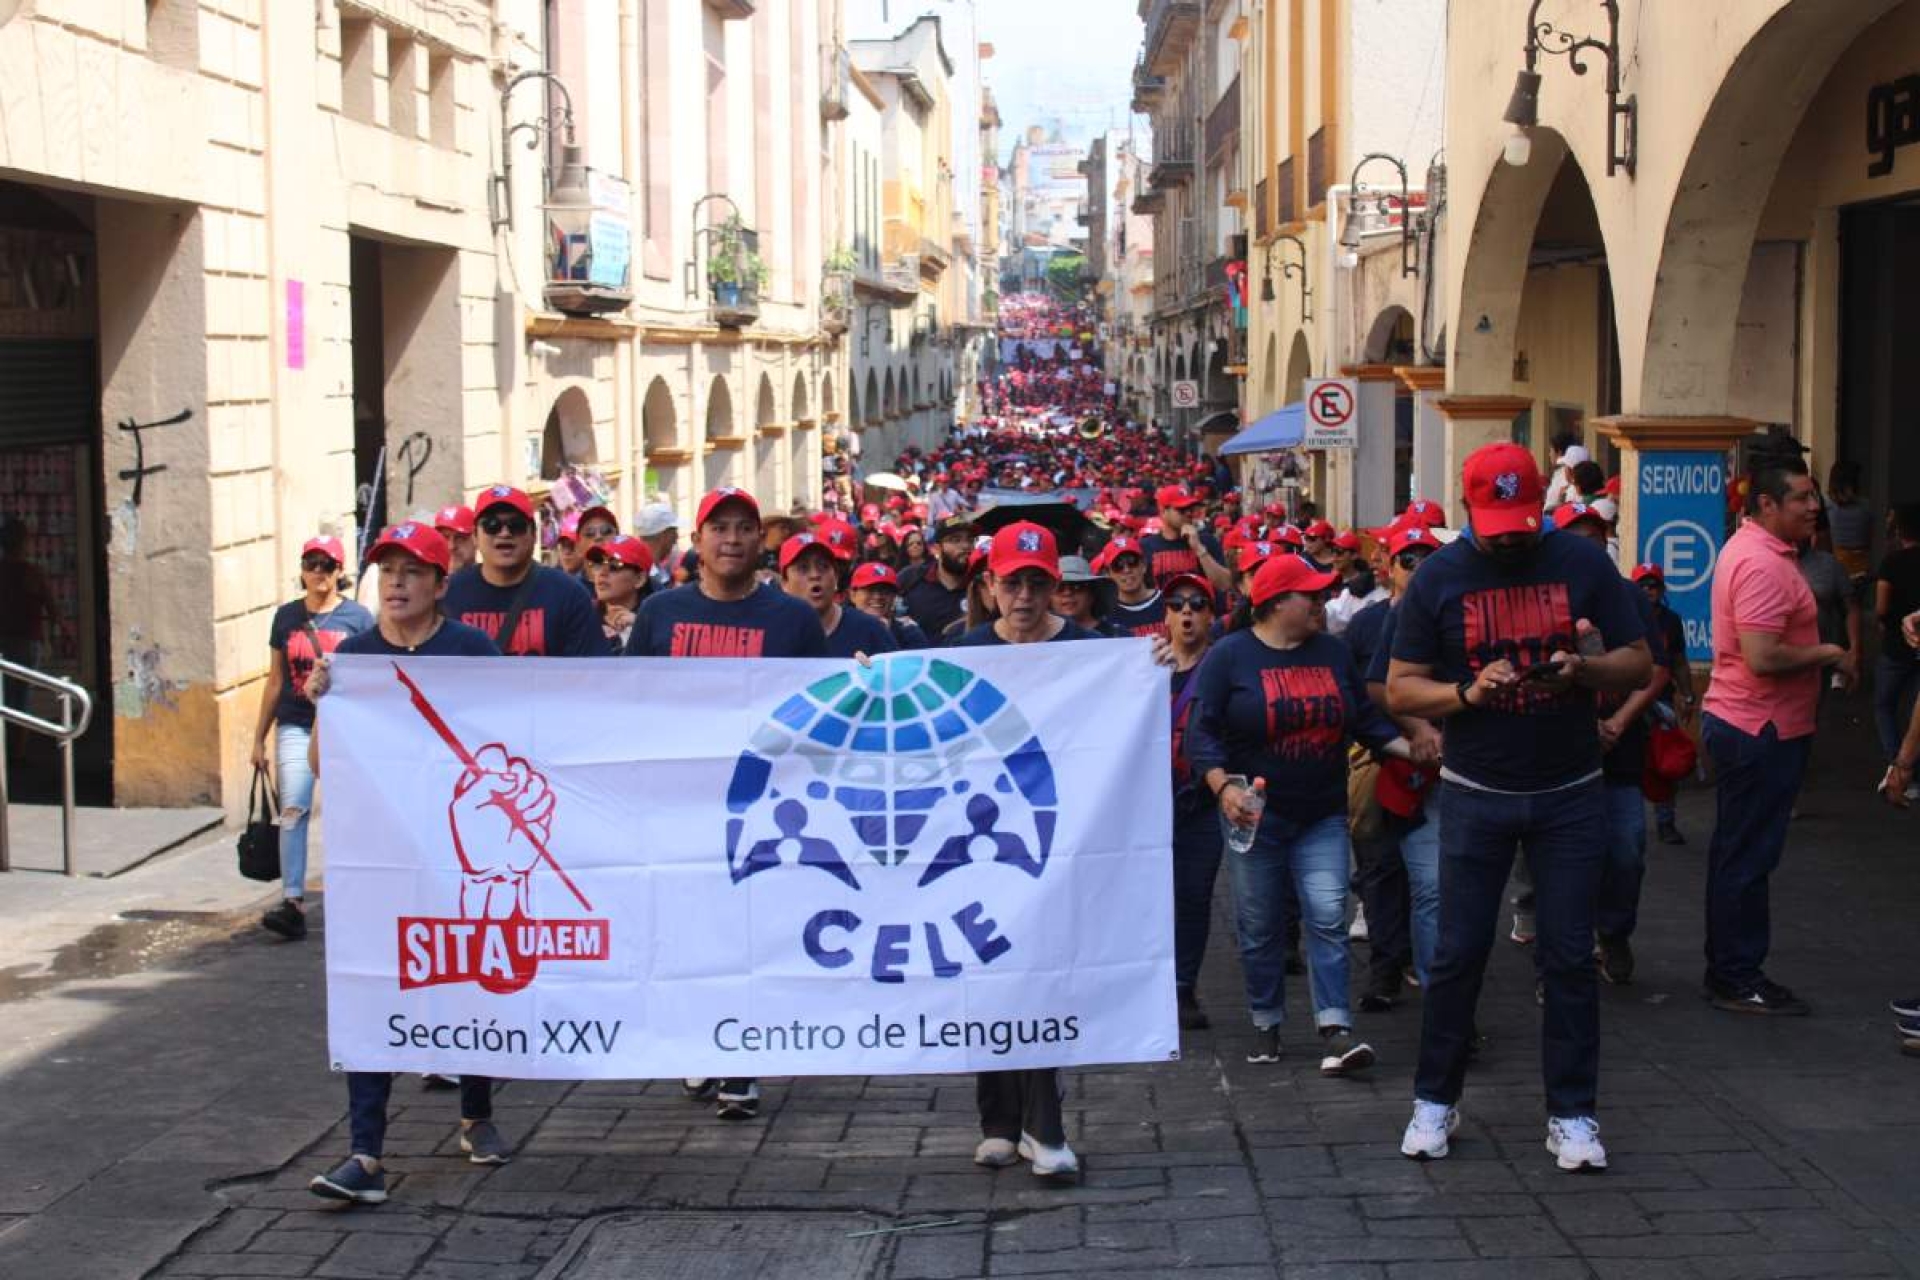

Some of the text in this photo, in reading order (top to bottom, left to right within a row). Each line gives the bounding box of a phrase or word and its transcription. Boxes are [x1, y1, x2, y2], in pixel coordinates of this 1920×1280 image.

[1641, 464, 1721, 495] SERVICIO
[1663, 535, 1696, 577] E
[406, 921, 601, 982] SITA UAEM
[802, 900, 1012, 984] CELE
[388, 1013, 622, 1054] Sección XXV
[713, 1013, 1080, 1055] Centro de Lenguas
